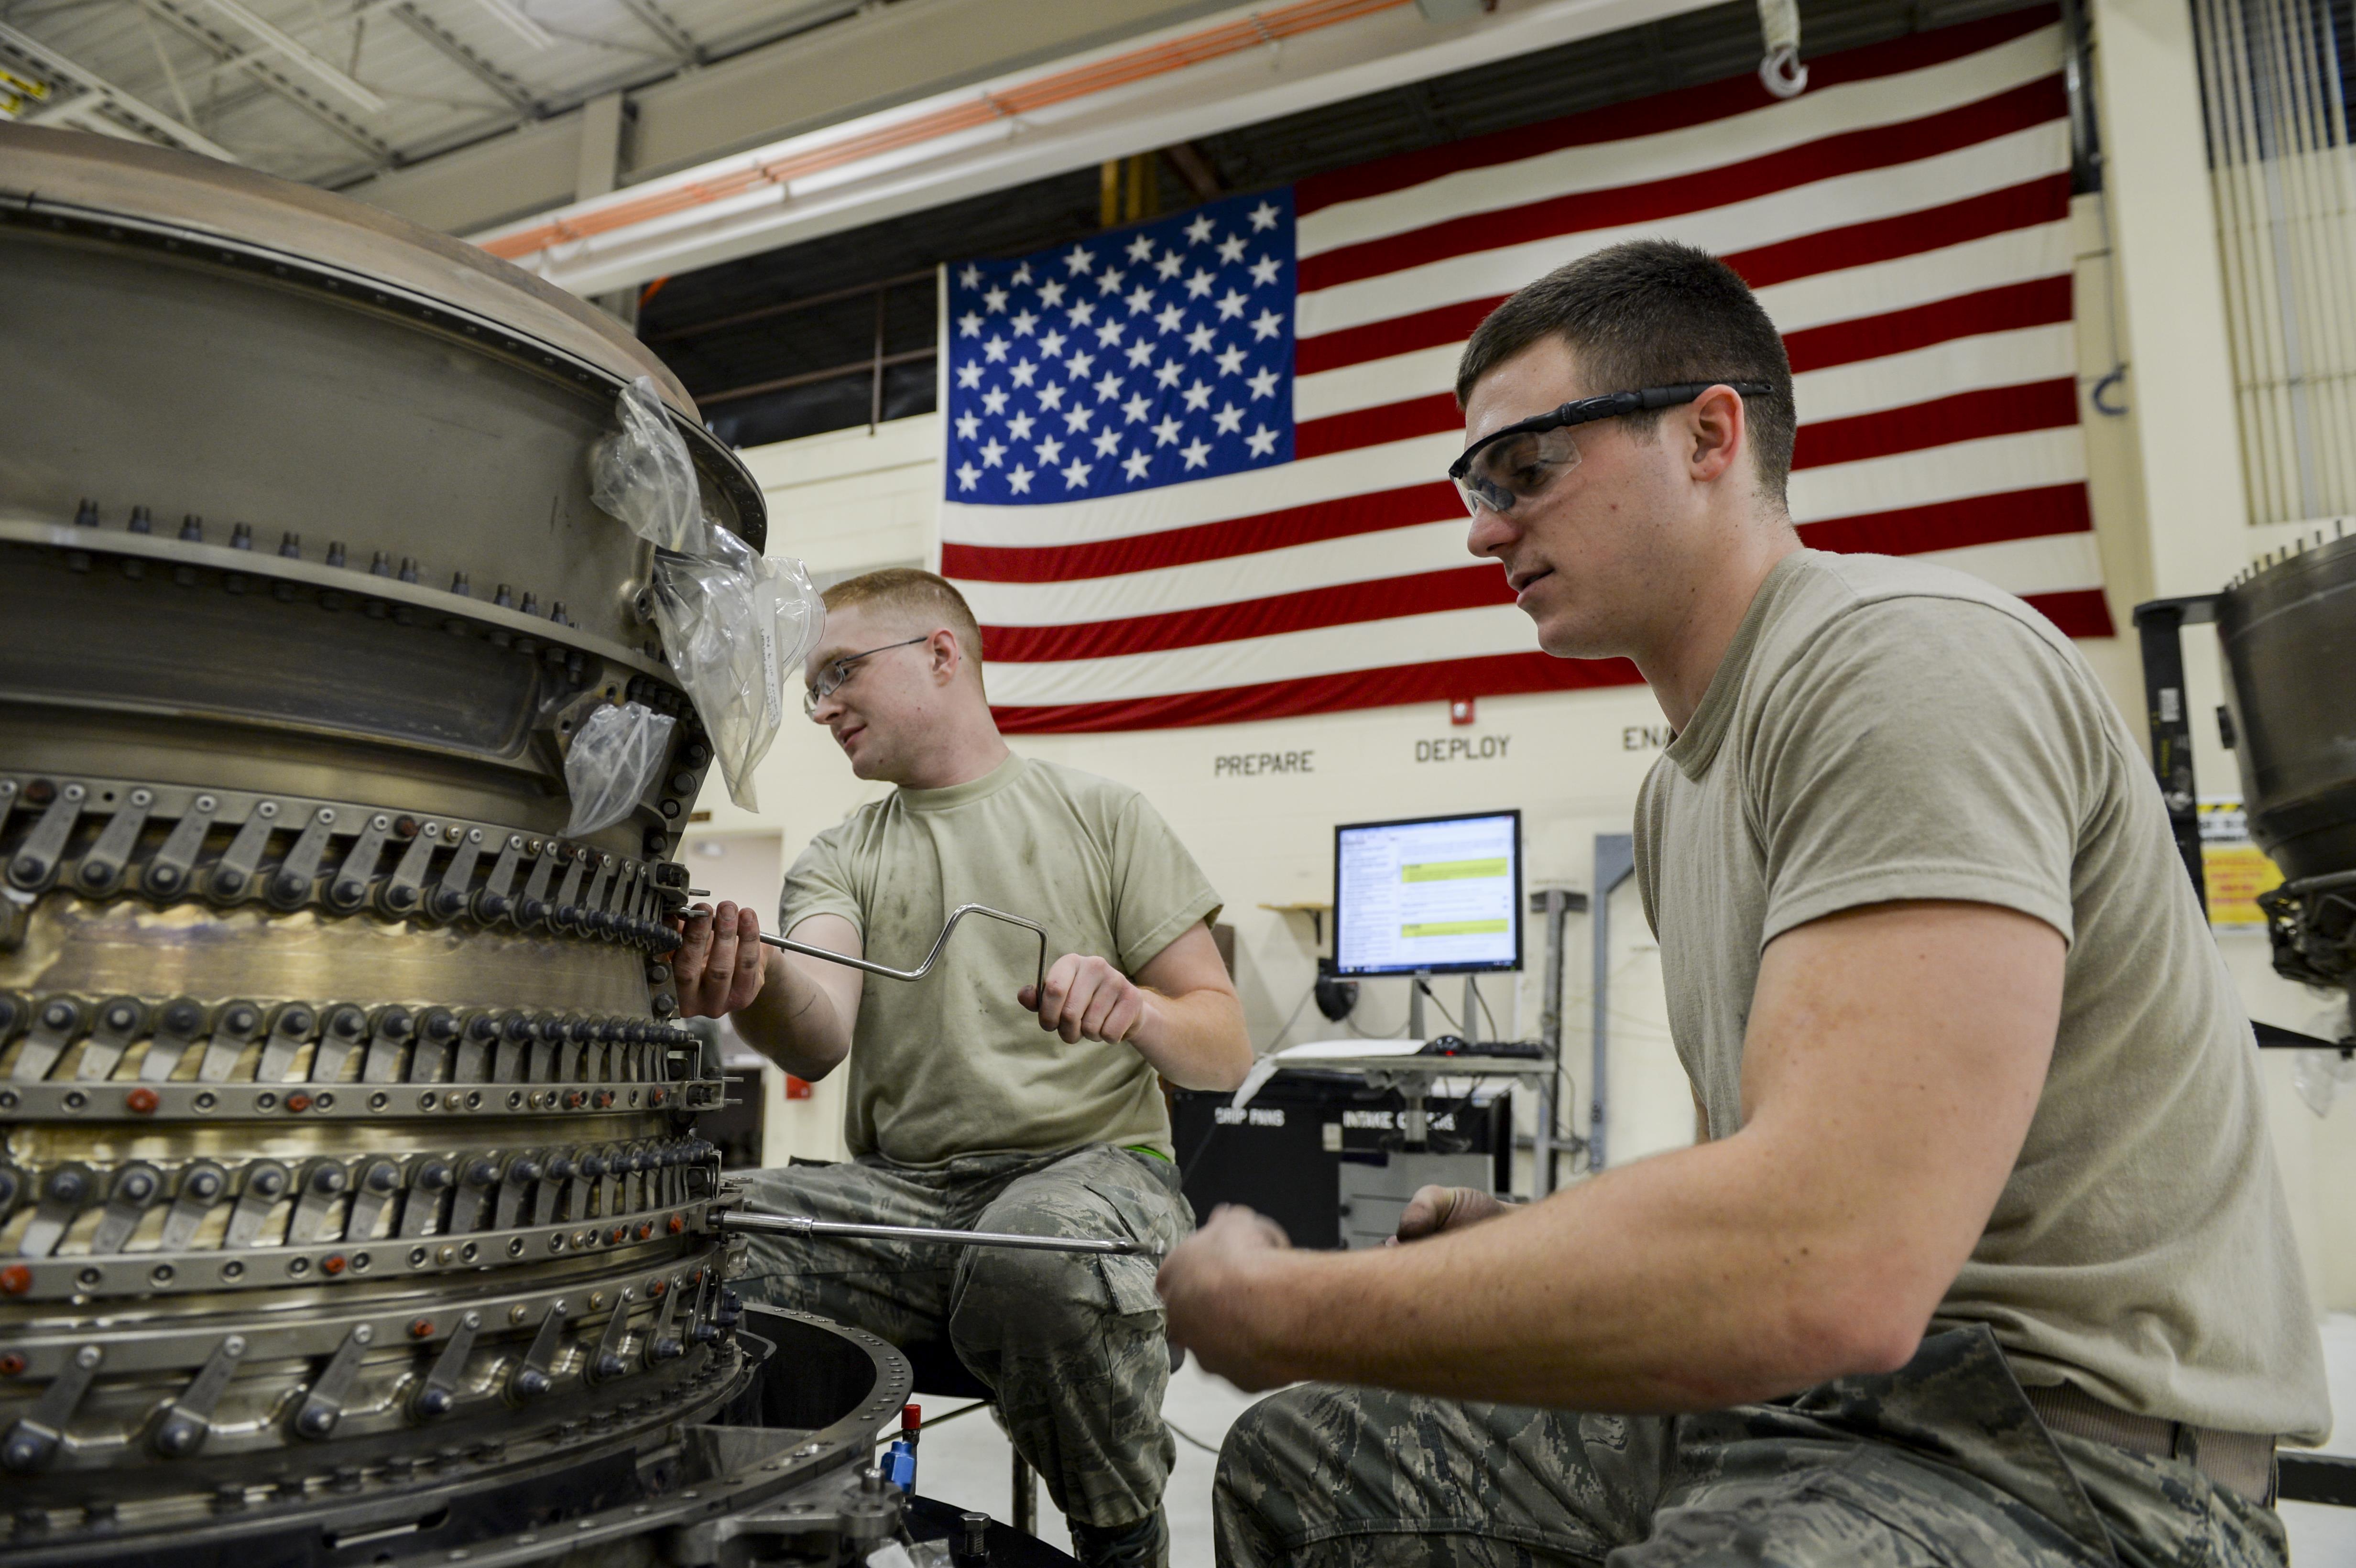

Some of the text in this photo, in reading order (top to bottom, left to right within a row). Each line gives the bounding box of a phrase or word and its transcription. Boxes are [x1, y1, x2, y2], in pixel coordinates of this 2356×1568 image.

[1416, 735, 1511, 762] DEPLOY
[1623, 726, 1669, 750] EN
[1214, 750, 1315, 777] PREPARE
[1215, 1107, 1247, 1124] DRIP
[1343, 1111, 1394, 1129] INTAKE
